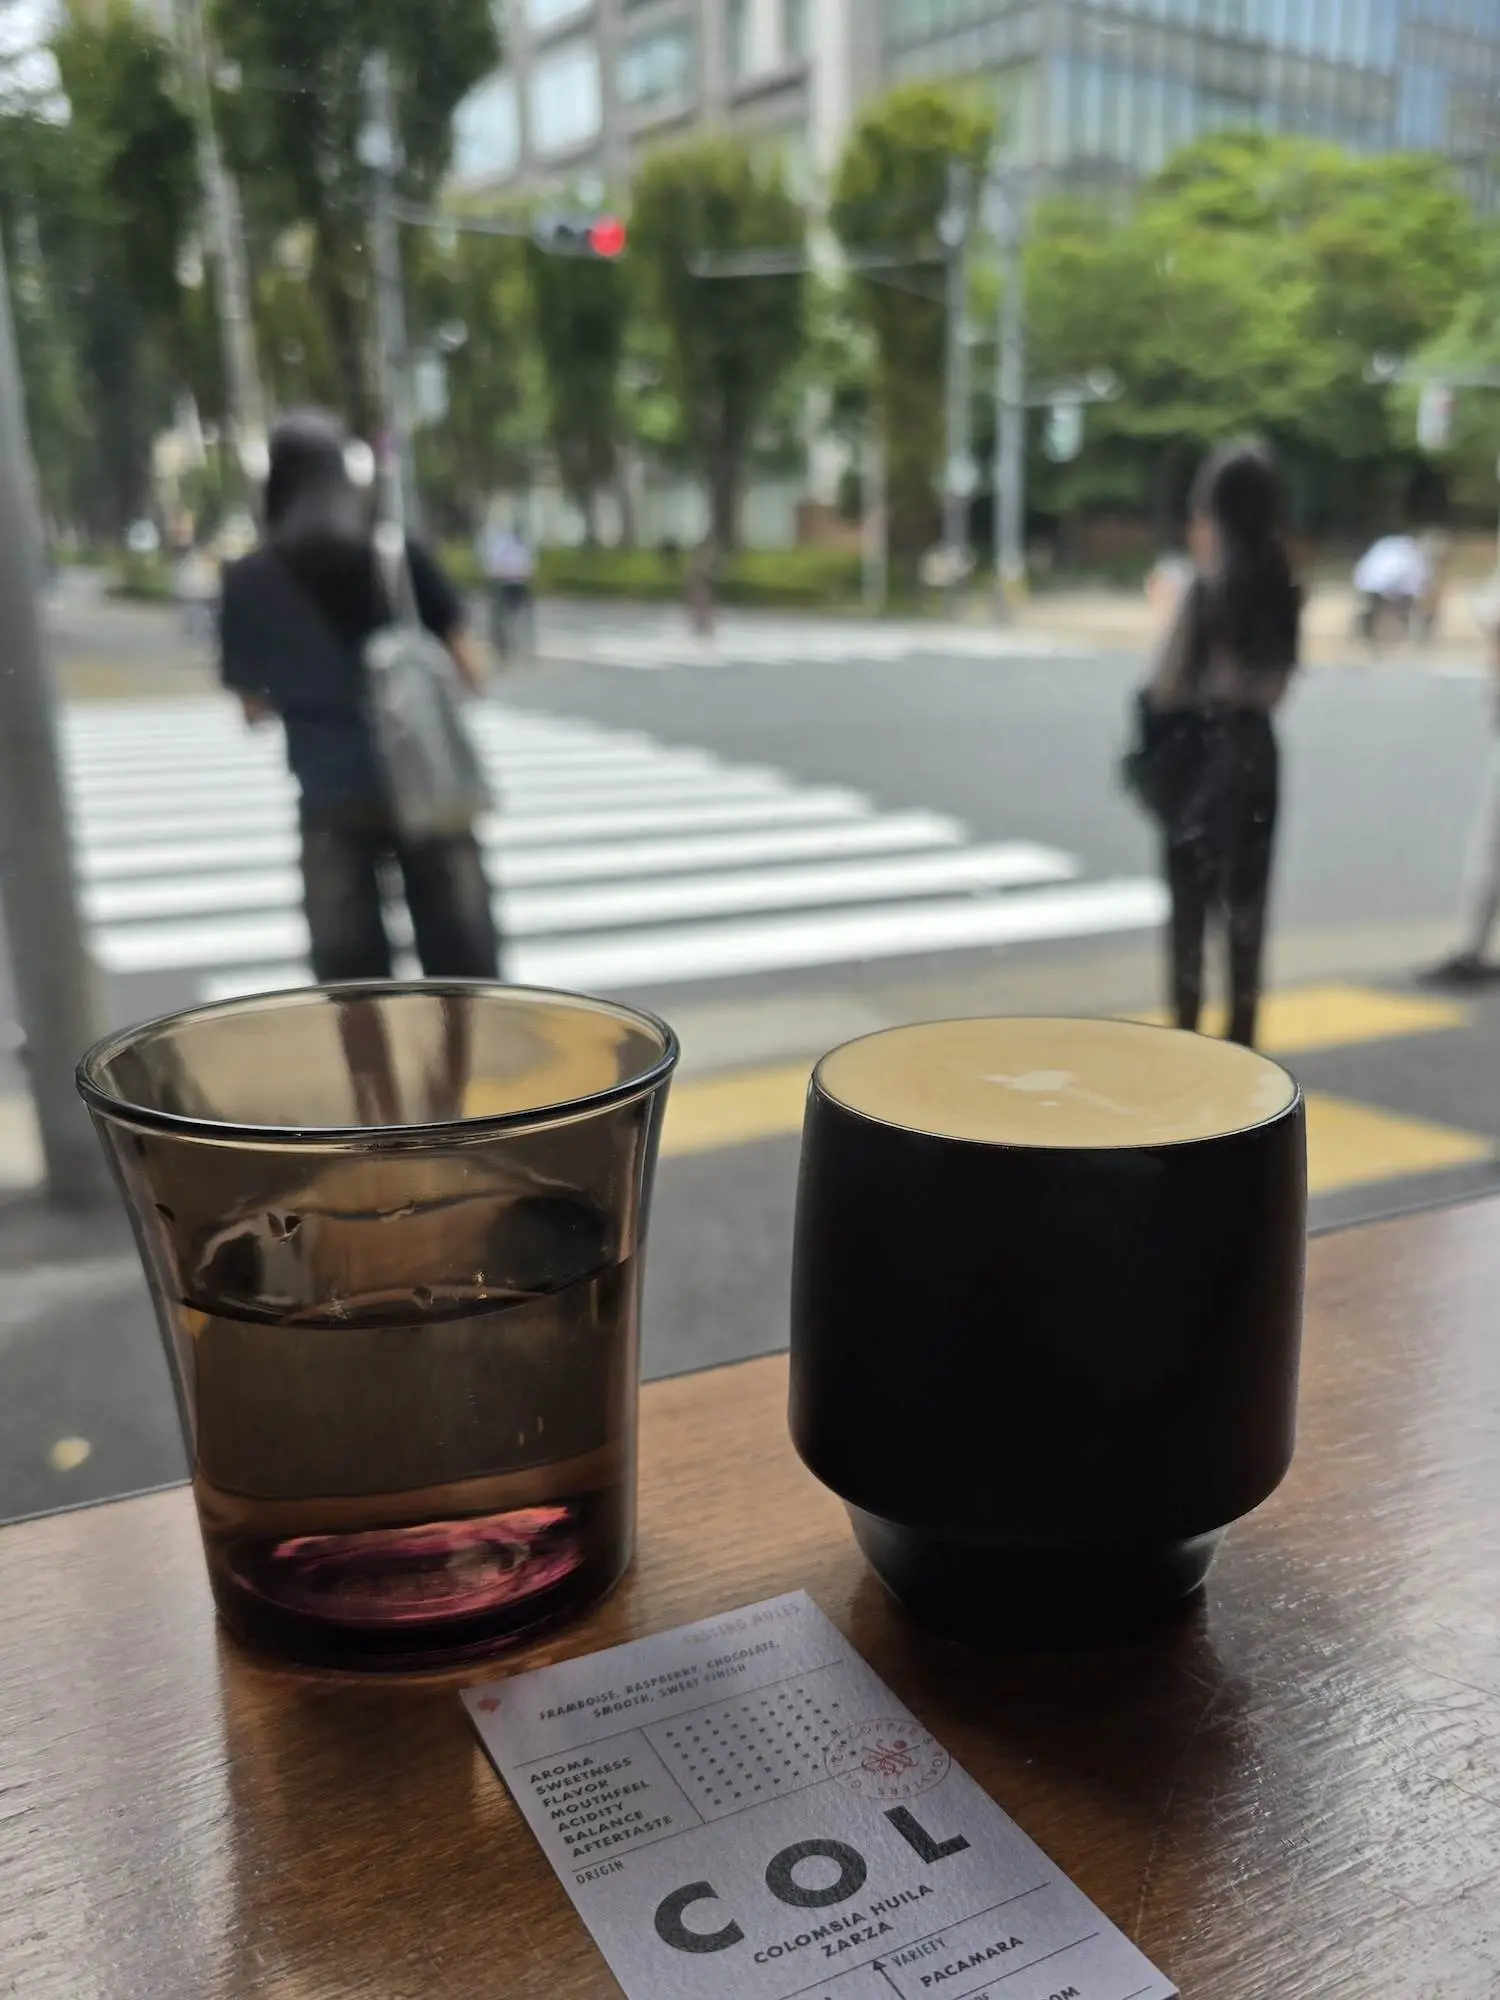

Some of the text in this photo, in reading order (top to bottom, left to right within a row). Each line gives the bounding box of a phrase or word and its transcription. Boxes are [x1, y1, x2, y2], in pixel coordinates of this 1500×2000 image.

[706, 1639, 780, 1670] CHOCOLATE,
[593, 1663, 747, 1718] SMOOTH, SWEET FINISH
[530, 1756, 594, 1784] AROMA
[535, 1756, 633, 1796] SWEETNESS
[542, 1779, 610, 1808] FLAVOR
[550, 1779, 651, 1820] MOUTHFEEL
[558, 1801, 625, 1833] ACIDITY
[563, 1809, 645, 1845] BALANCE
[572, 1814, 674, 1858] AFTERTASTE
[575, 1859, 625, 1885] ORIGIN
[753, 1883, 934, 1964] COLOMBIA HUILA
[820, 1921, 894, 1958] ZARZA
[891, 1935, 947, 1969] VARIETY
[919, 1935, 1024, 1988] PACAMARA
